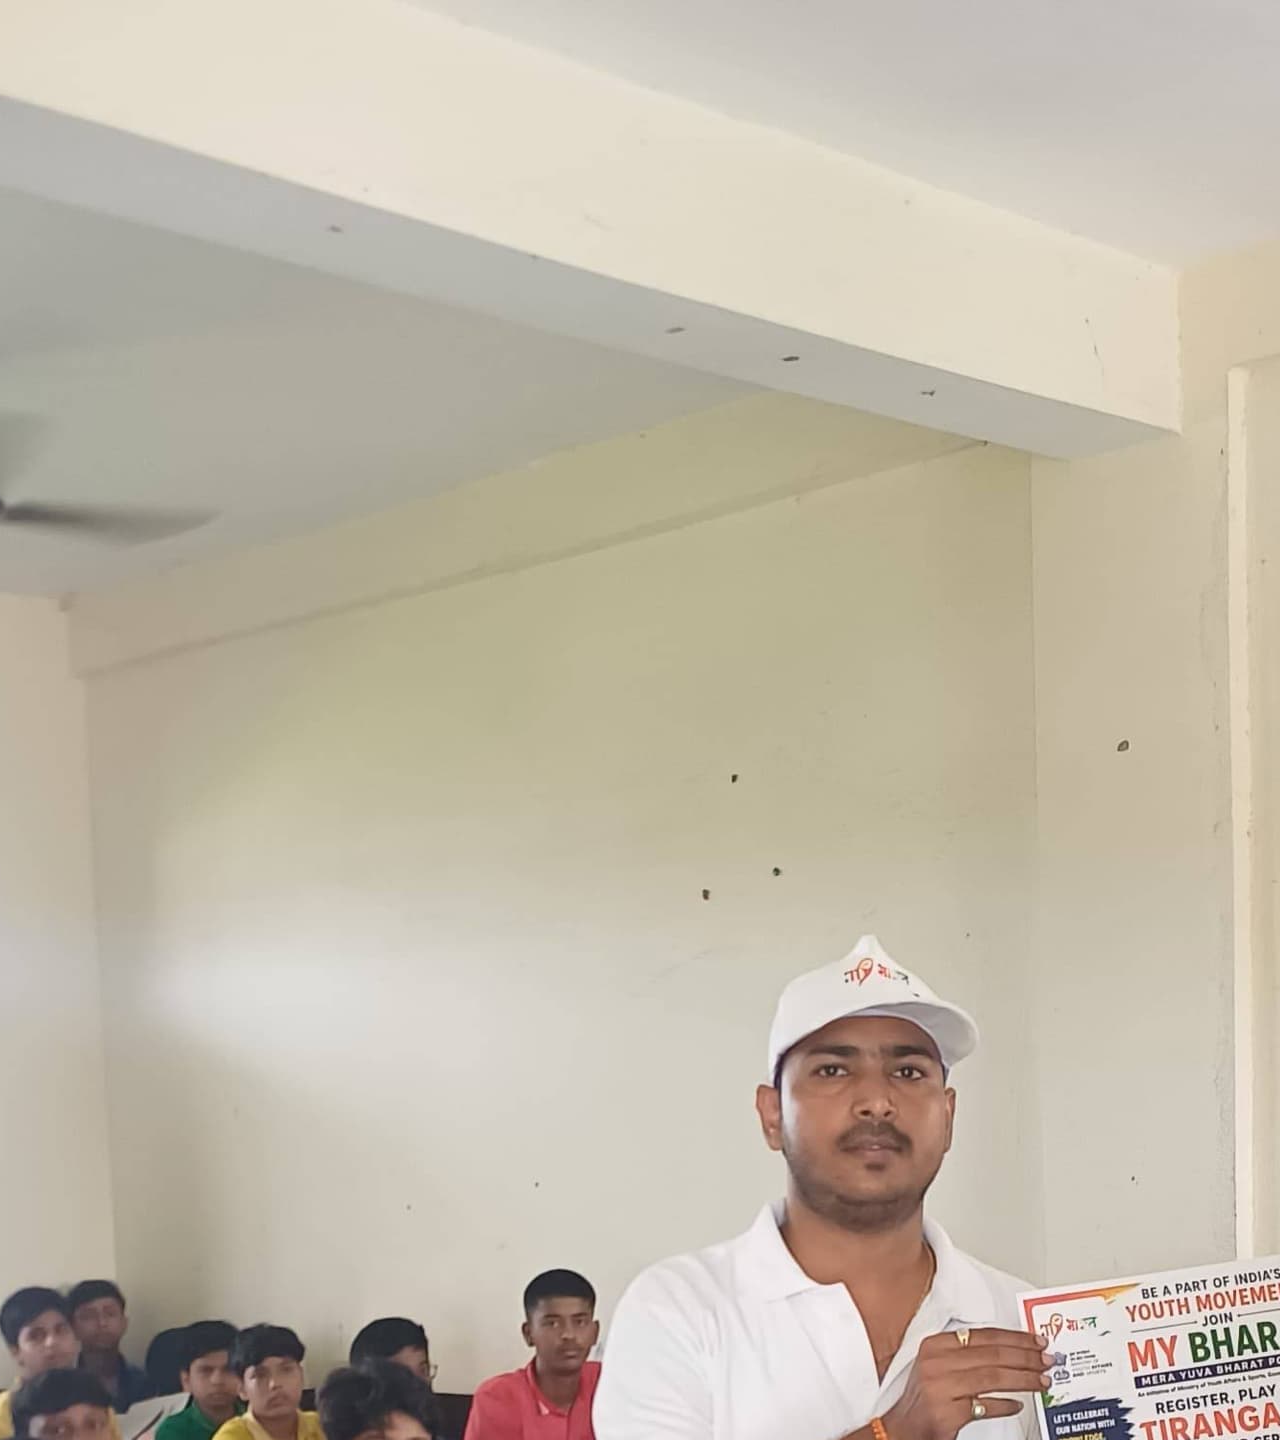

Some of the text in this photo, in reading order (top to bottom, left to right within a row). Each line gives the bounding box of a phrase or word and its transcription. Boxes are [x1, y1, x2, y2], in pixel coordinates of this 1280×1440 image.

[1141, 1268, 1280, 1299] BE A PART OF INDIA'S
[1125, 1296, 1190, 1322] YOUTH
[1202, 1311, 1233, 1327] JOIN
[1127, 1334, 1177, 1372] MY
[1140, 1371, 1177, 1386] MERA
[1178, 1365, 1212, 1381] YUVA
[1215, 1358, 1264, 1374] BHARAT
[1155, 1392, 1234, 1414] REGISTER,
[1238, 1384, 1274, 1401] PLAY
